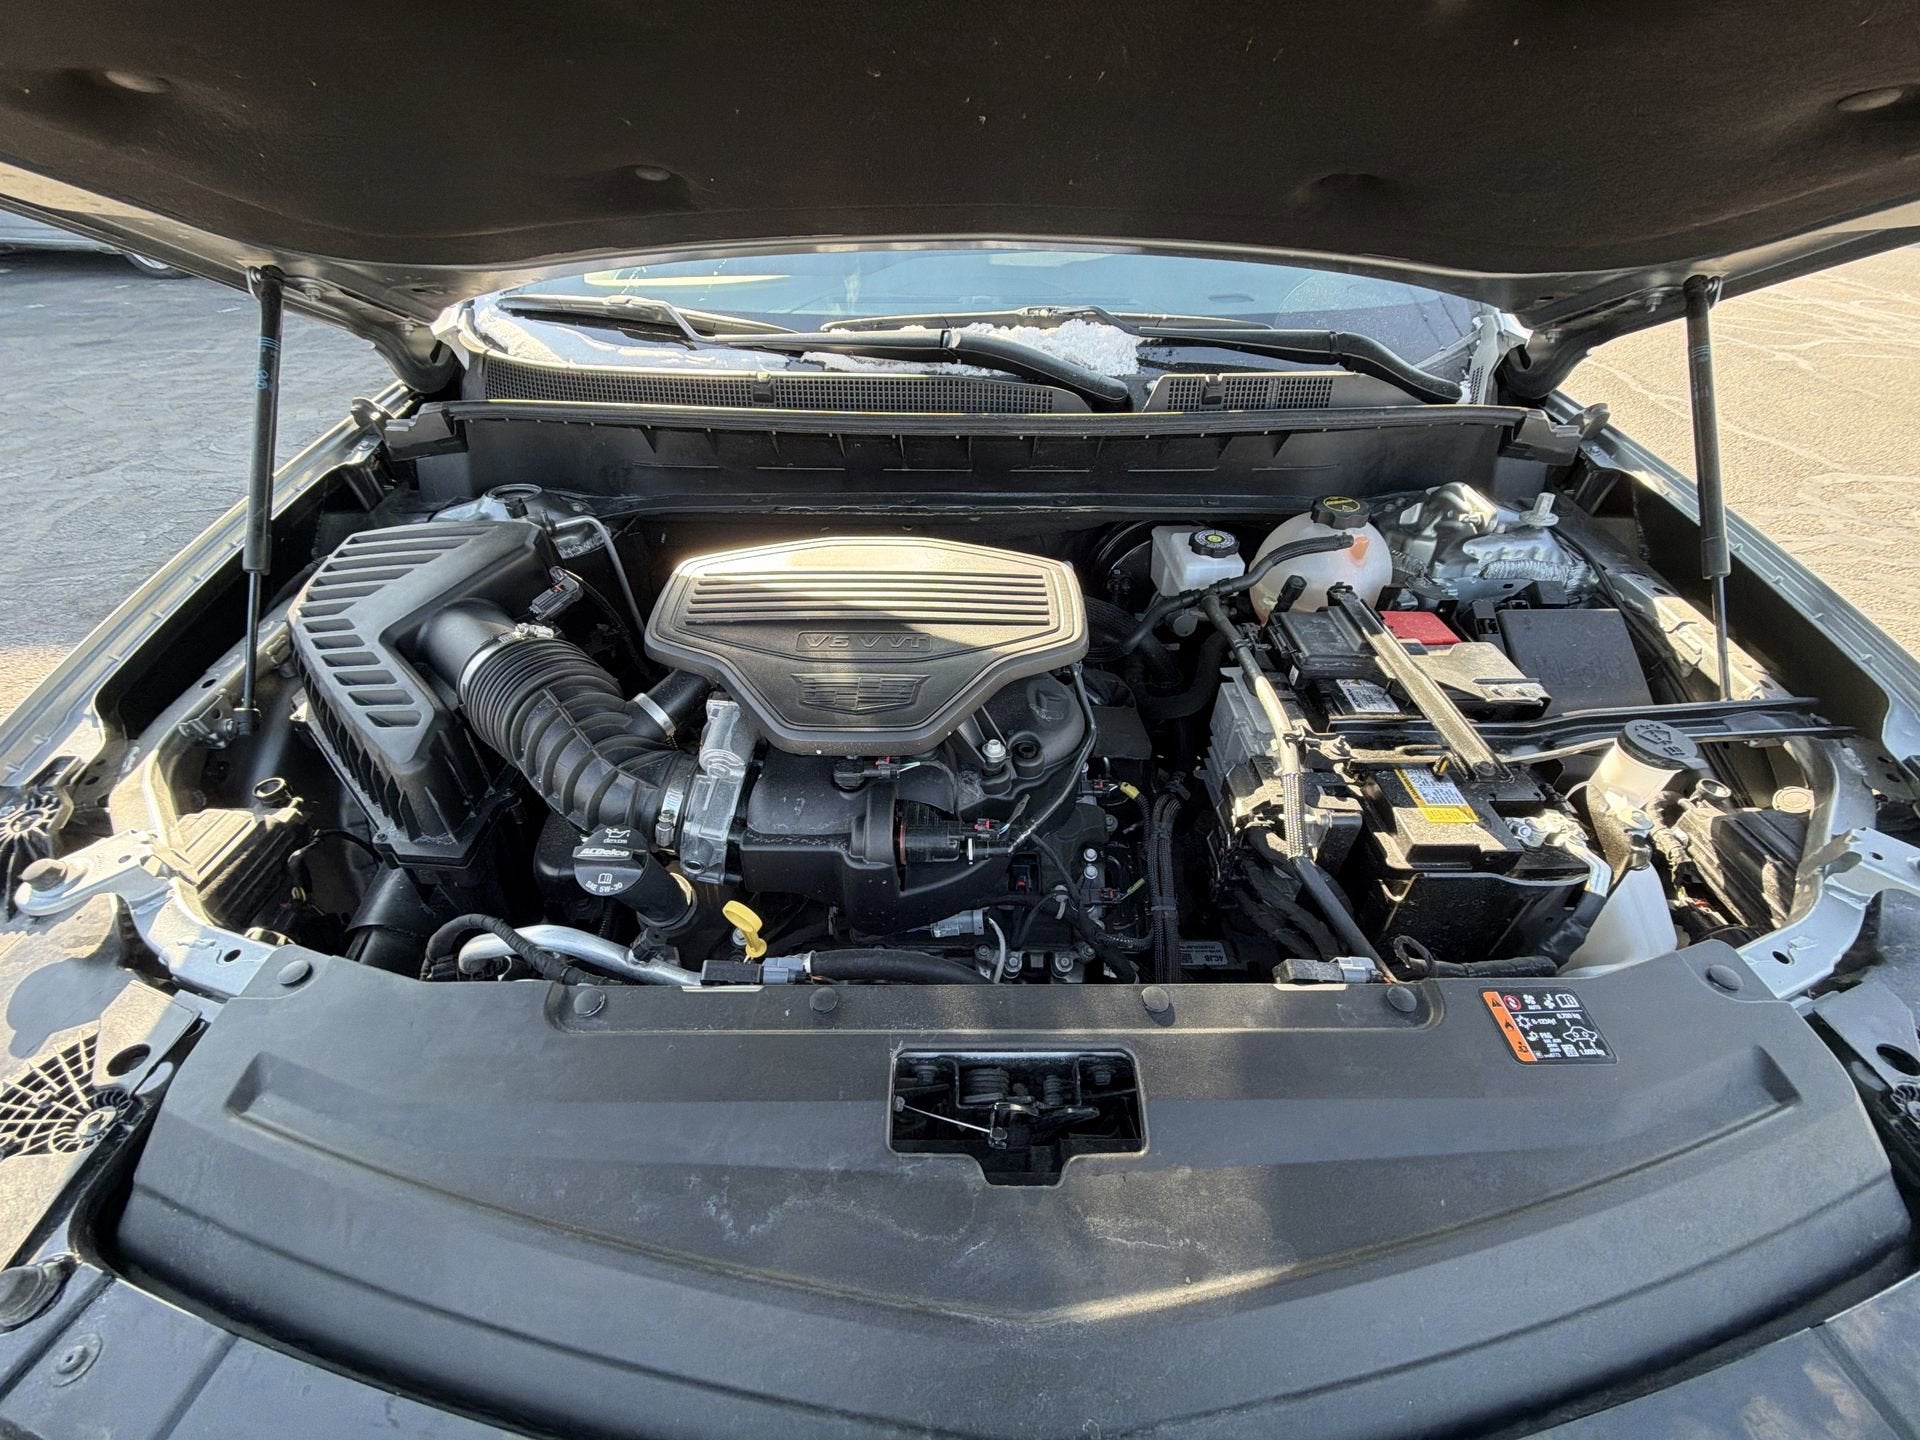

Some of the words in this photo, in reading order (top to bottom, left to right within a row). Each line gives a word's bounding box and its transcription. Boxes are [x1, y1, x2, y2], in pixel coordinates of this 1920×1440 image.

[803, 633, 850, 648] V6
[860, 634, 928, 649] VVT
[585, 880, 598, 891] SAE
[599, 881, 623, 893] 5W-30
